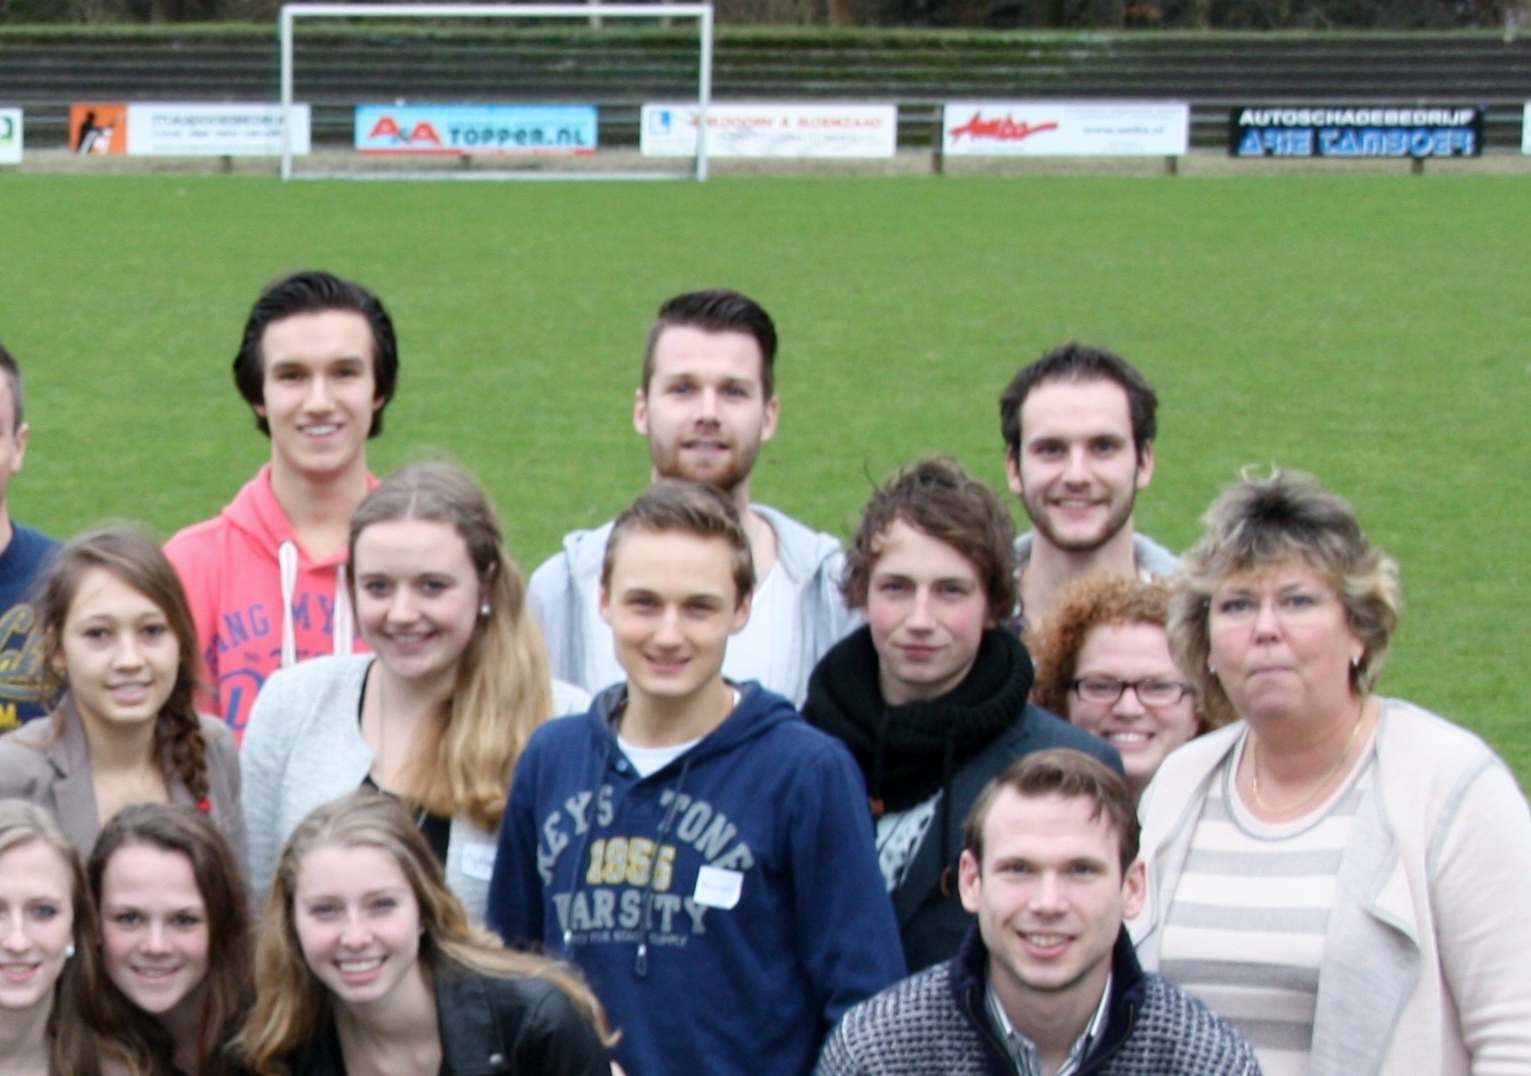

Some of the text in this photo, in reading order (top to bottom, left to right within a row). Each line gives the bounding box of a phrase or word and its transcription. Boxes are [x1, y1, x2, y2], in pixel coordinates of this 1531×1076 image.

[1239, 108, 1475, 126] AUTOSCHADEBEDRIJF
[1238, 128, 1314, 157] ARIE
[552, 889, 709, 935] VARSITY
